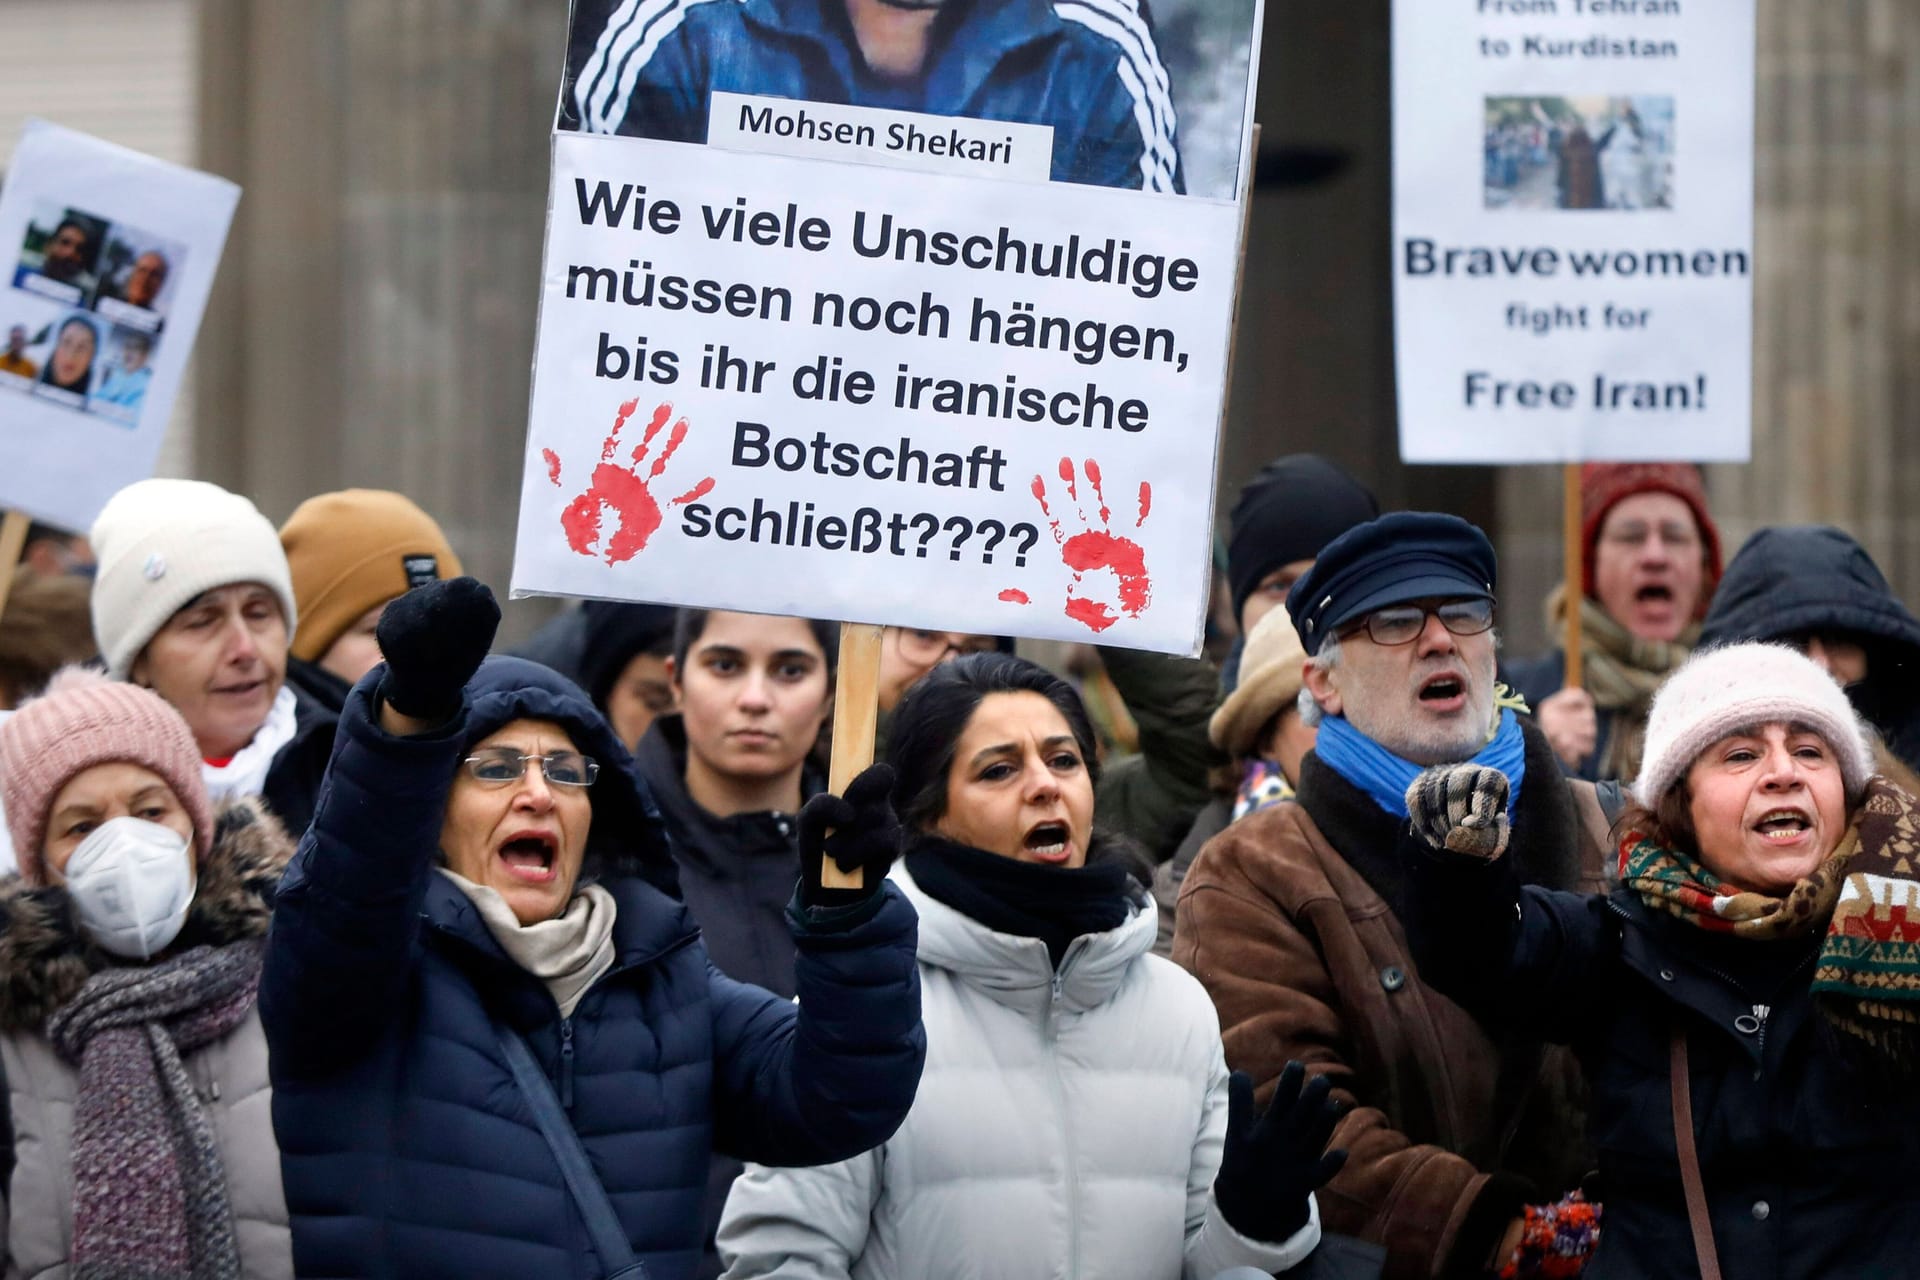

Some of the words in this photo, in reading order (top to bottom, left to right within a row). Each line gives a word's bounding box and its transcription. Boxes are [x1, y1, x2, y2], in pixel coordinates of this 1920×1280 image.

[1478, 35, 1511, 57] to
[1522, 34, 1679, 58] Kurdistan
[740, 104, 875, 147] Mohsen
[886, 123, 1012, 164] Shekari
[574, 177, 681, 235] Wie
[701, 197, 831, 252] viele
[852, 210, 1199, 299] Unschuldige
[1403, 238, 1560, 277] Brave
[1568, 249, 1749, 278] women
[566, 260, 792, 322] müssen
[812, 291, 950, 339] noch
[969, 297, 1189, 373] hängen,
[1505, 303, 1589, 334] fight
[1602, 304, 1650, 328] for
[595, 332, 680, 385] bis
[700, 343, 776, 394] ihr
[792, 355, 875, 405] die
[894, 363, 1149, 433] iranische
[1464, 371, 1577, 408] Free
[1592, 373, 1707, 410] Iran!
[731, 421, 1008, 492] Botschaft
[681, 497, 1039, 568] schließt????
